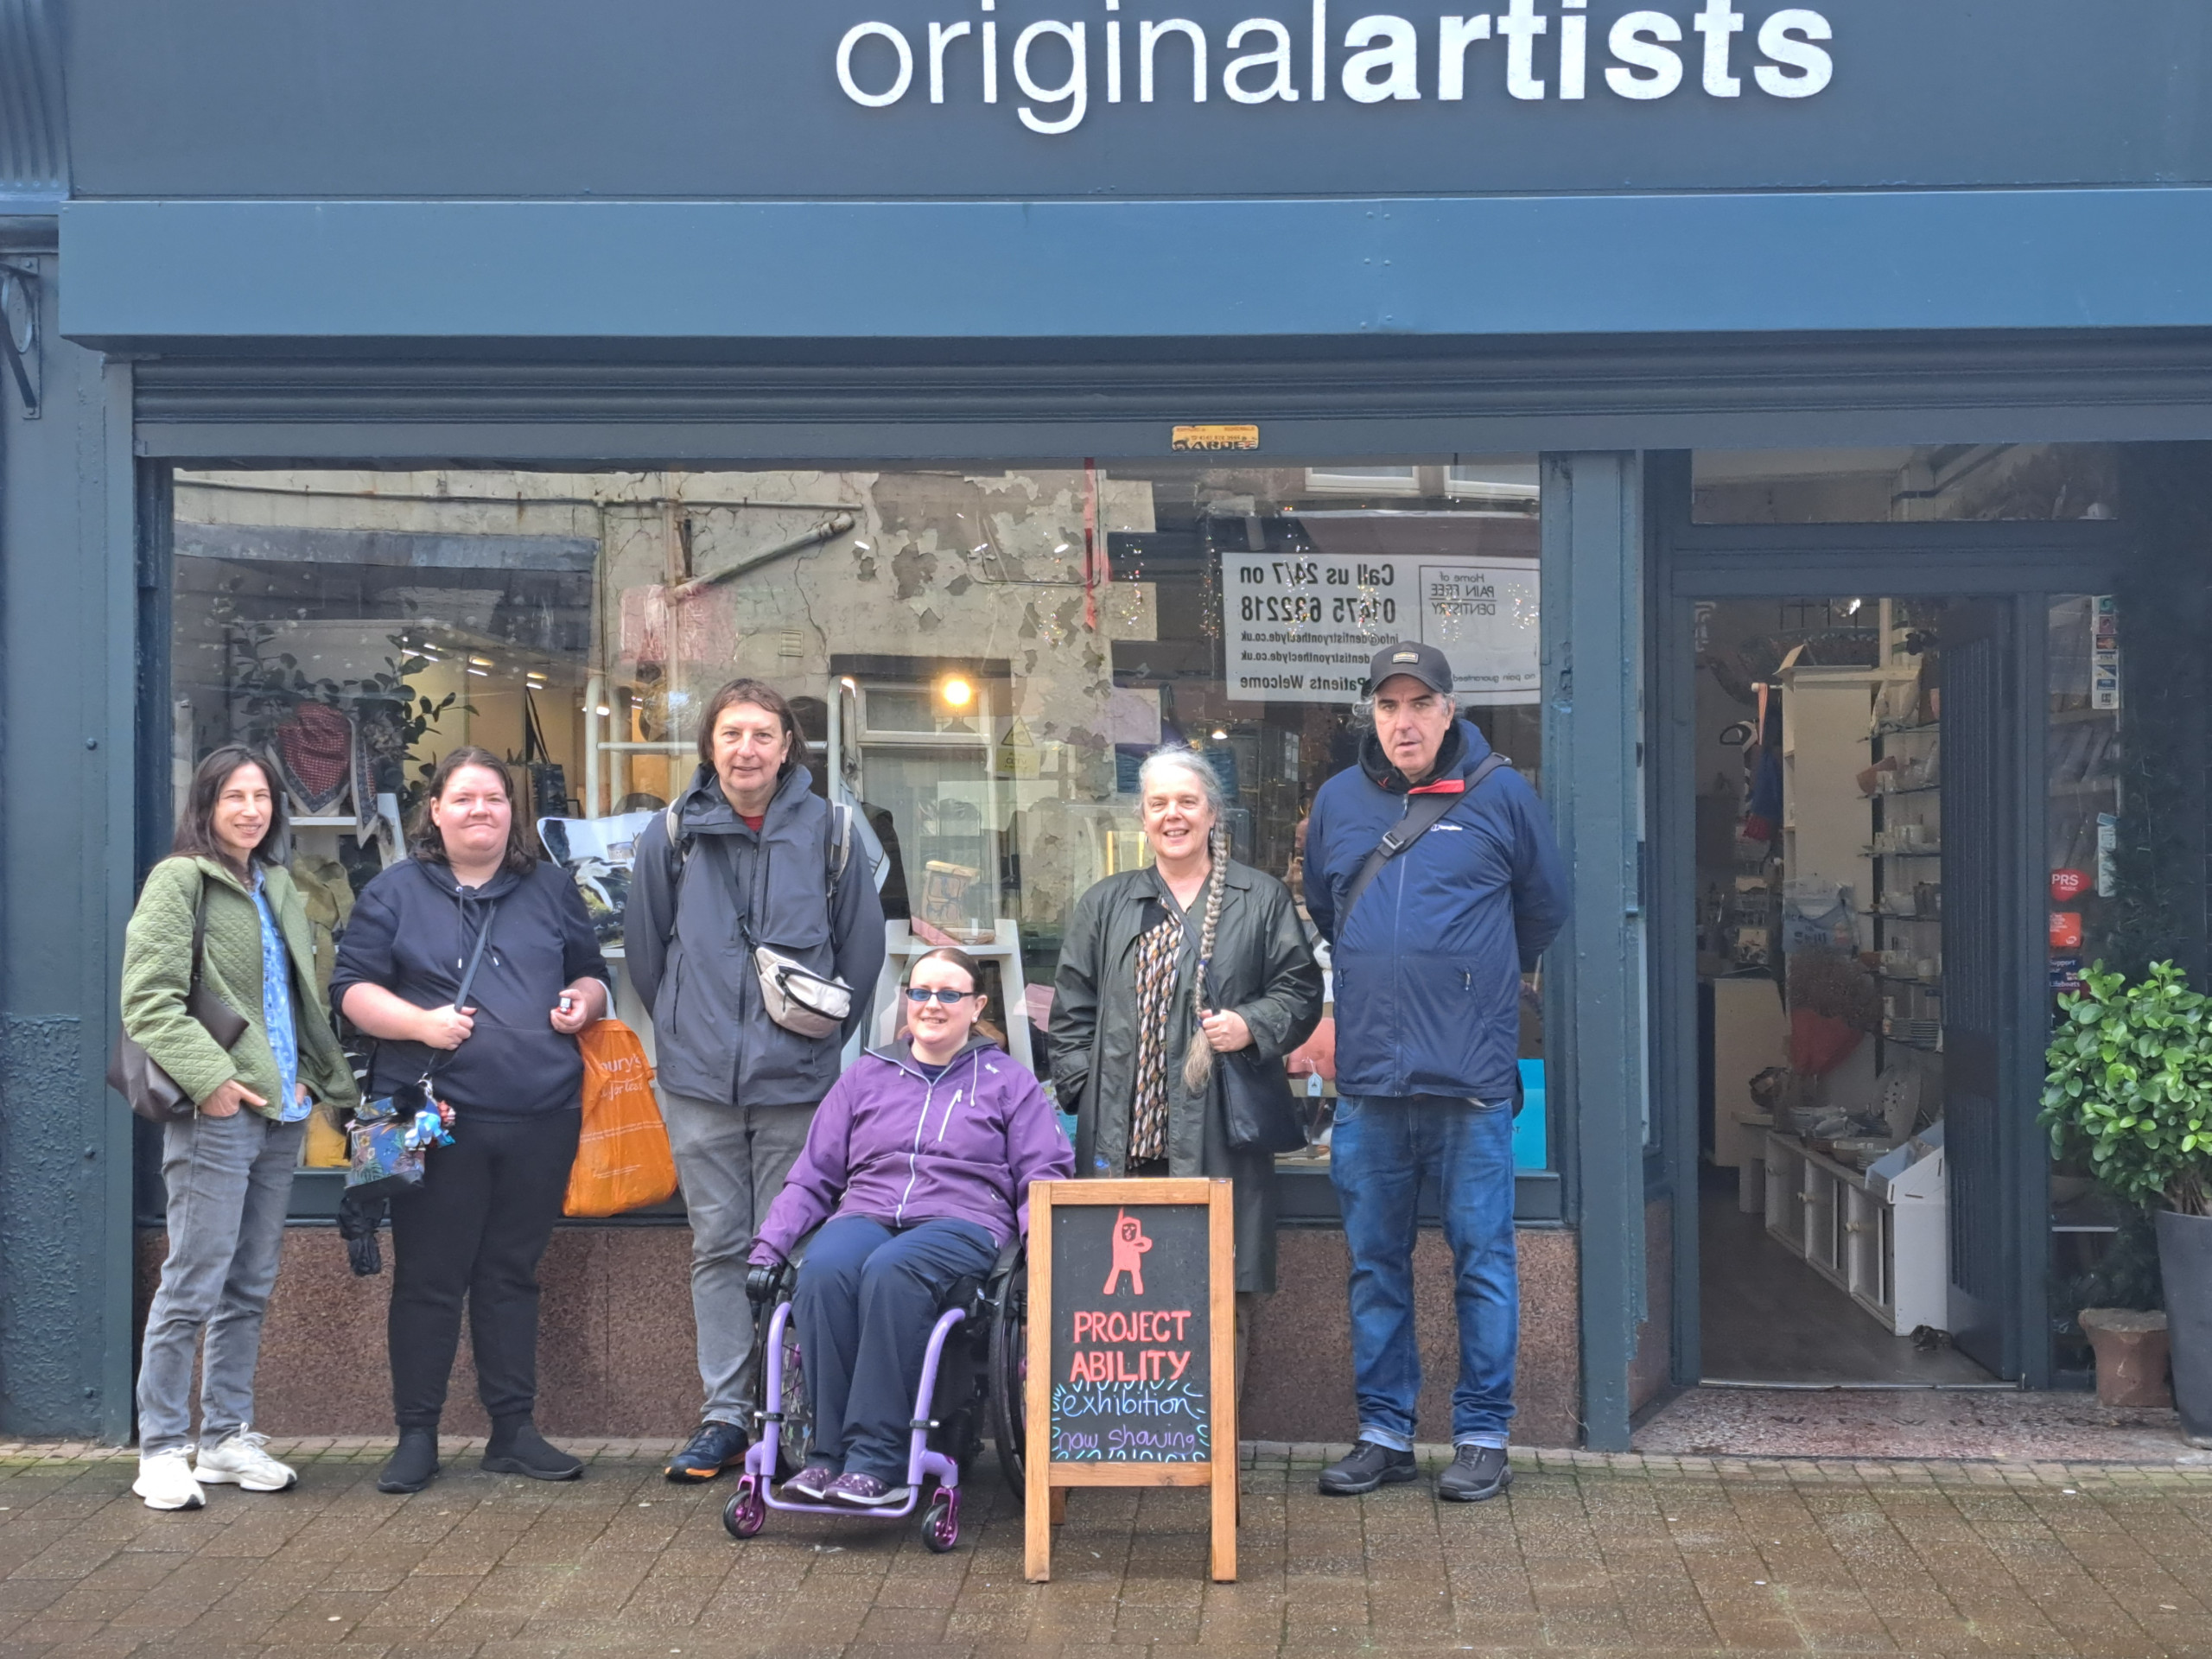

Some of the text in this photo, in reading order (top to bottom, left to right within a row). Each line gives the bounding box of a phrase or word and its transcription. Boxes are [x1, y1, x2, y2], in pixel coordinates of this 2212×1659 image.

[2051, 874, 2079, 887] PRS
[1073, 1310, 1192, 1344] PROJECT
[1069, 1351, 1192, 1382] ABILITY
[1059, 1431, 1098, 1452] now
